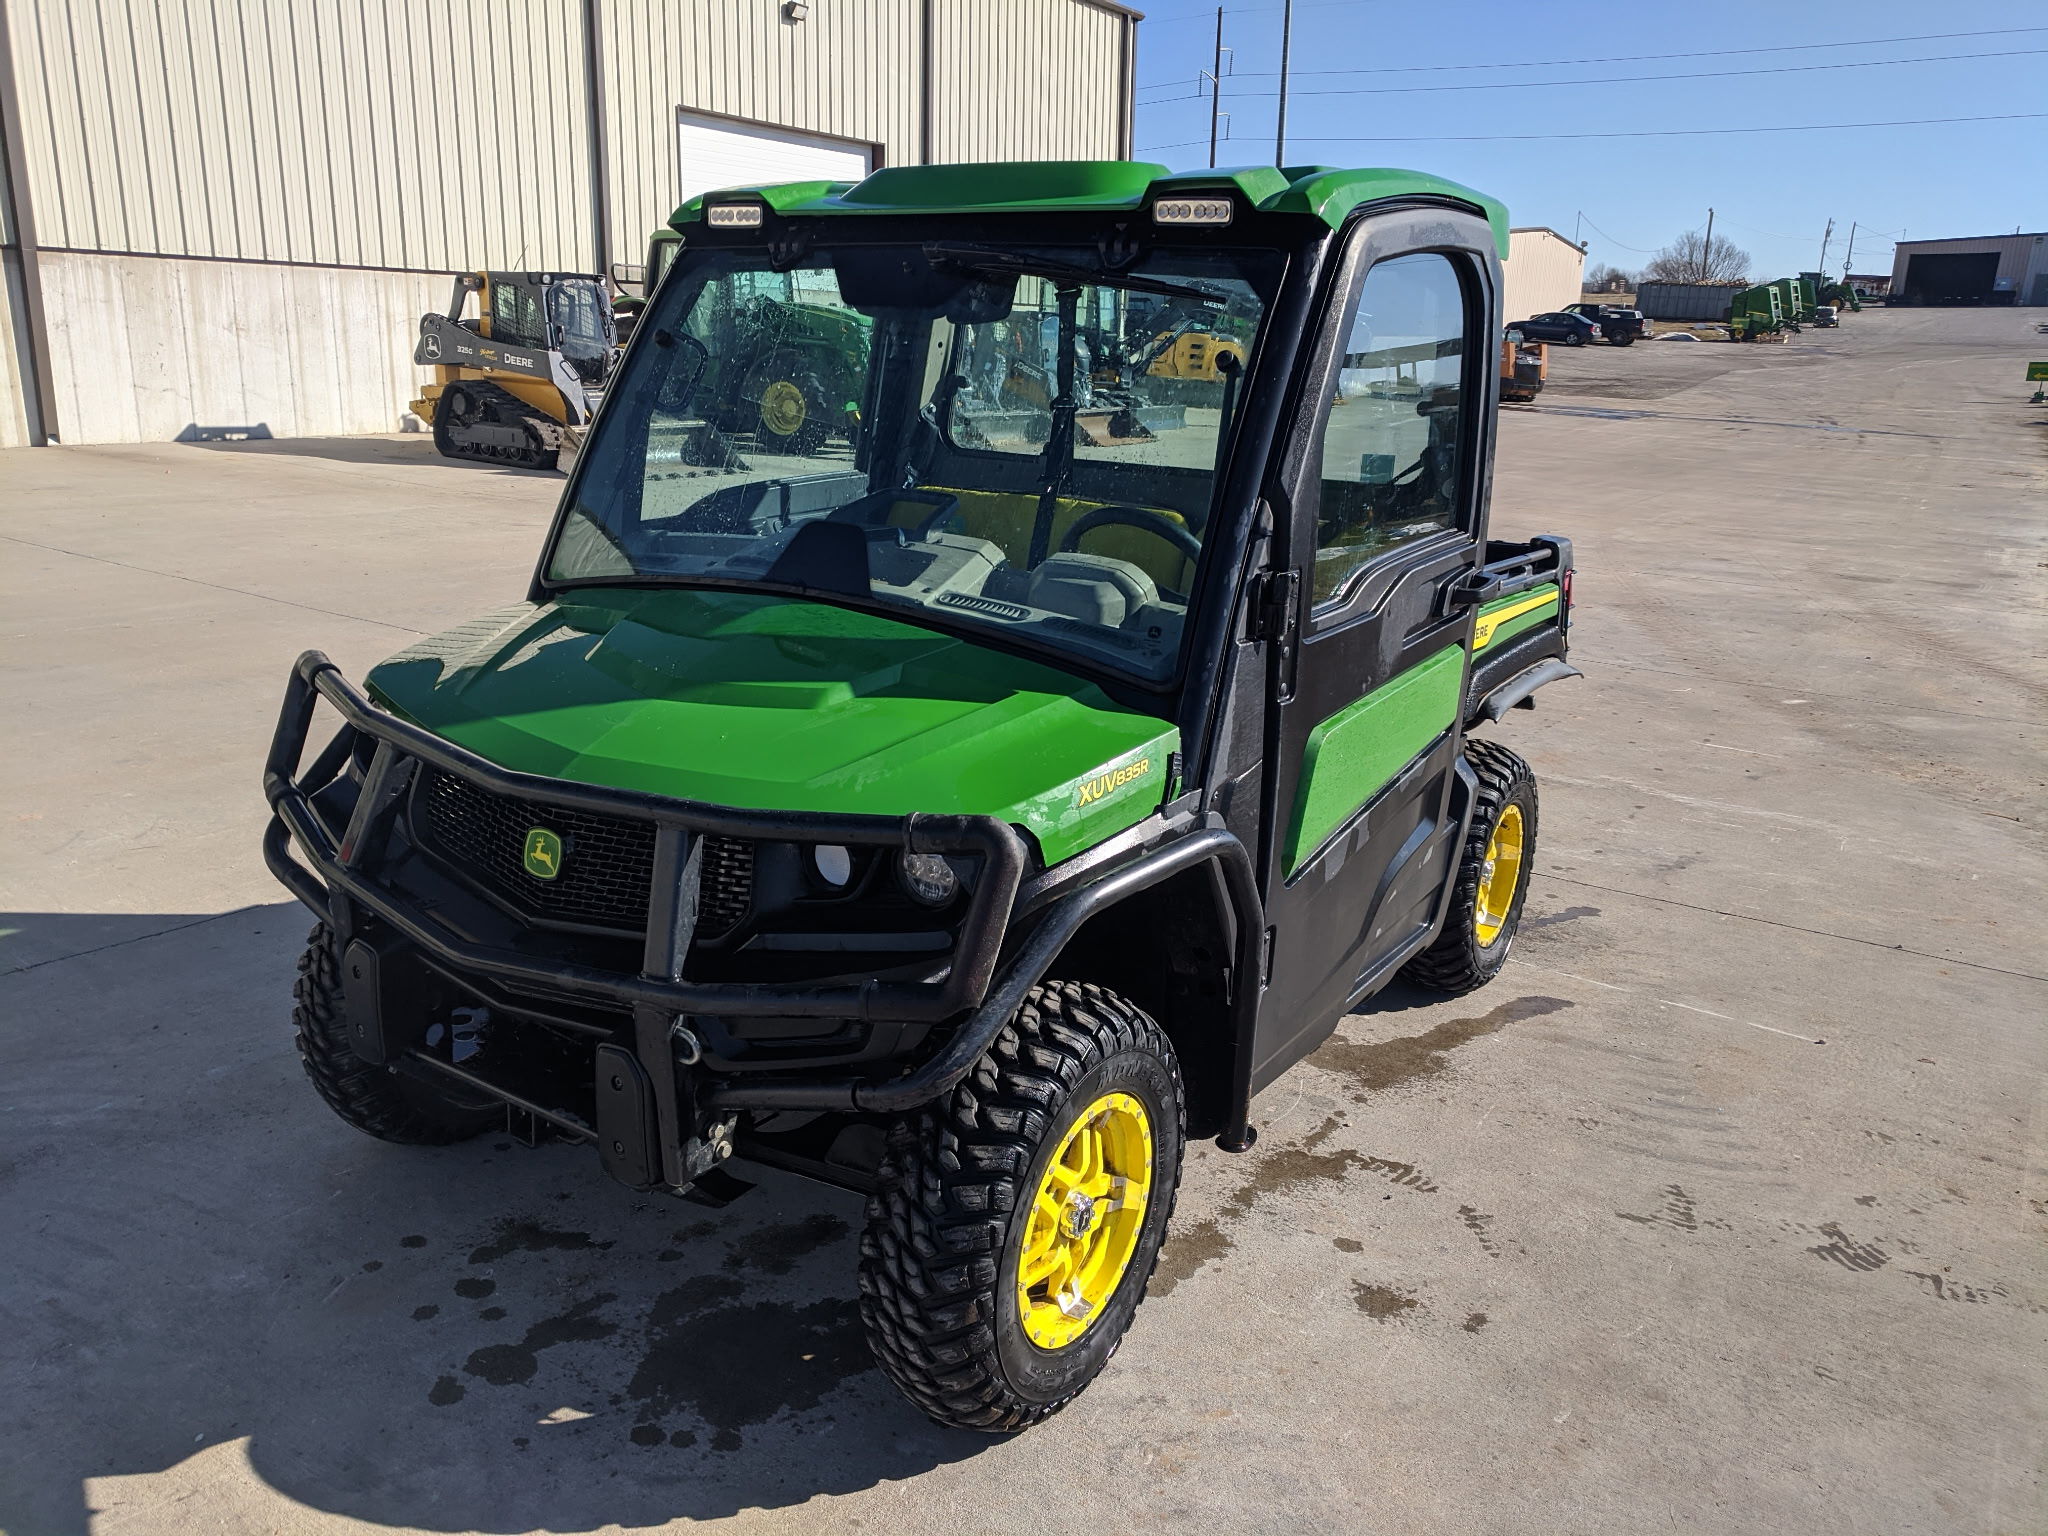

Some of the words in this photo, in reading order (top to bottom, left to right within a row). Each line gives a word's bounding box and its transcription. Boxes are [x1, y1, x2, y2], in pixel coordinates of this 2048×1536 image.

[504, 352, 534, 368] DEERE
[1017, 361, 1043, 380] DEERE
[1475, 624, 1489, 640] ERE
[1078, 758, 1149, 807] XUV835R
